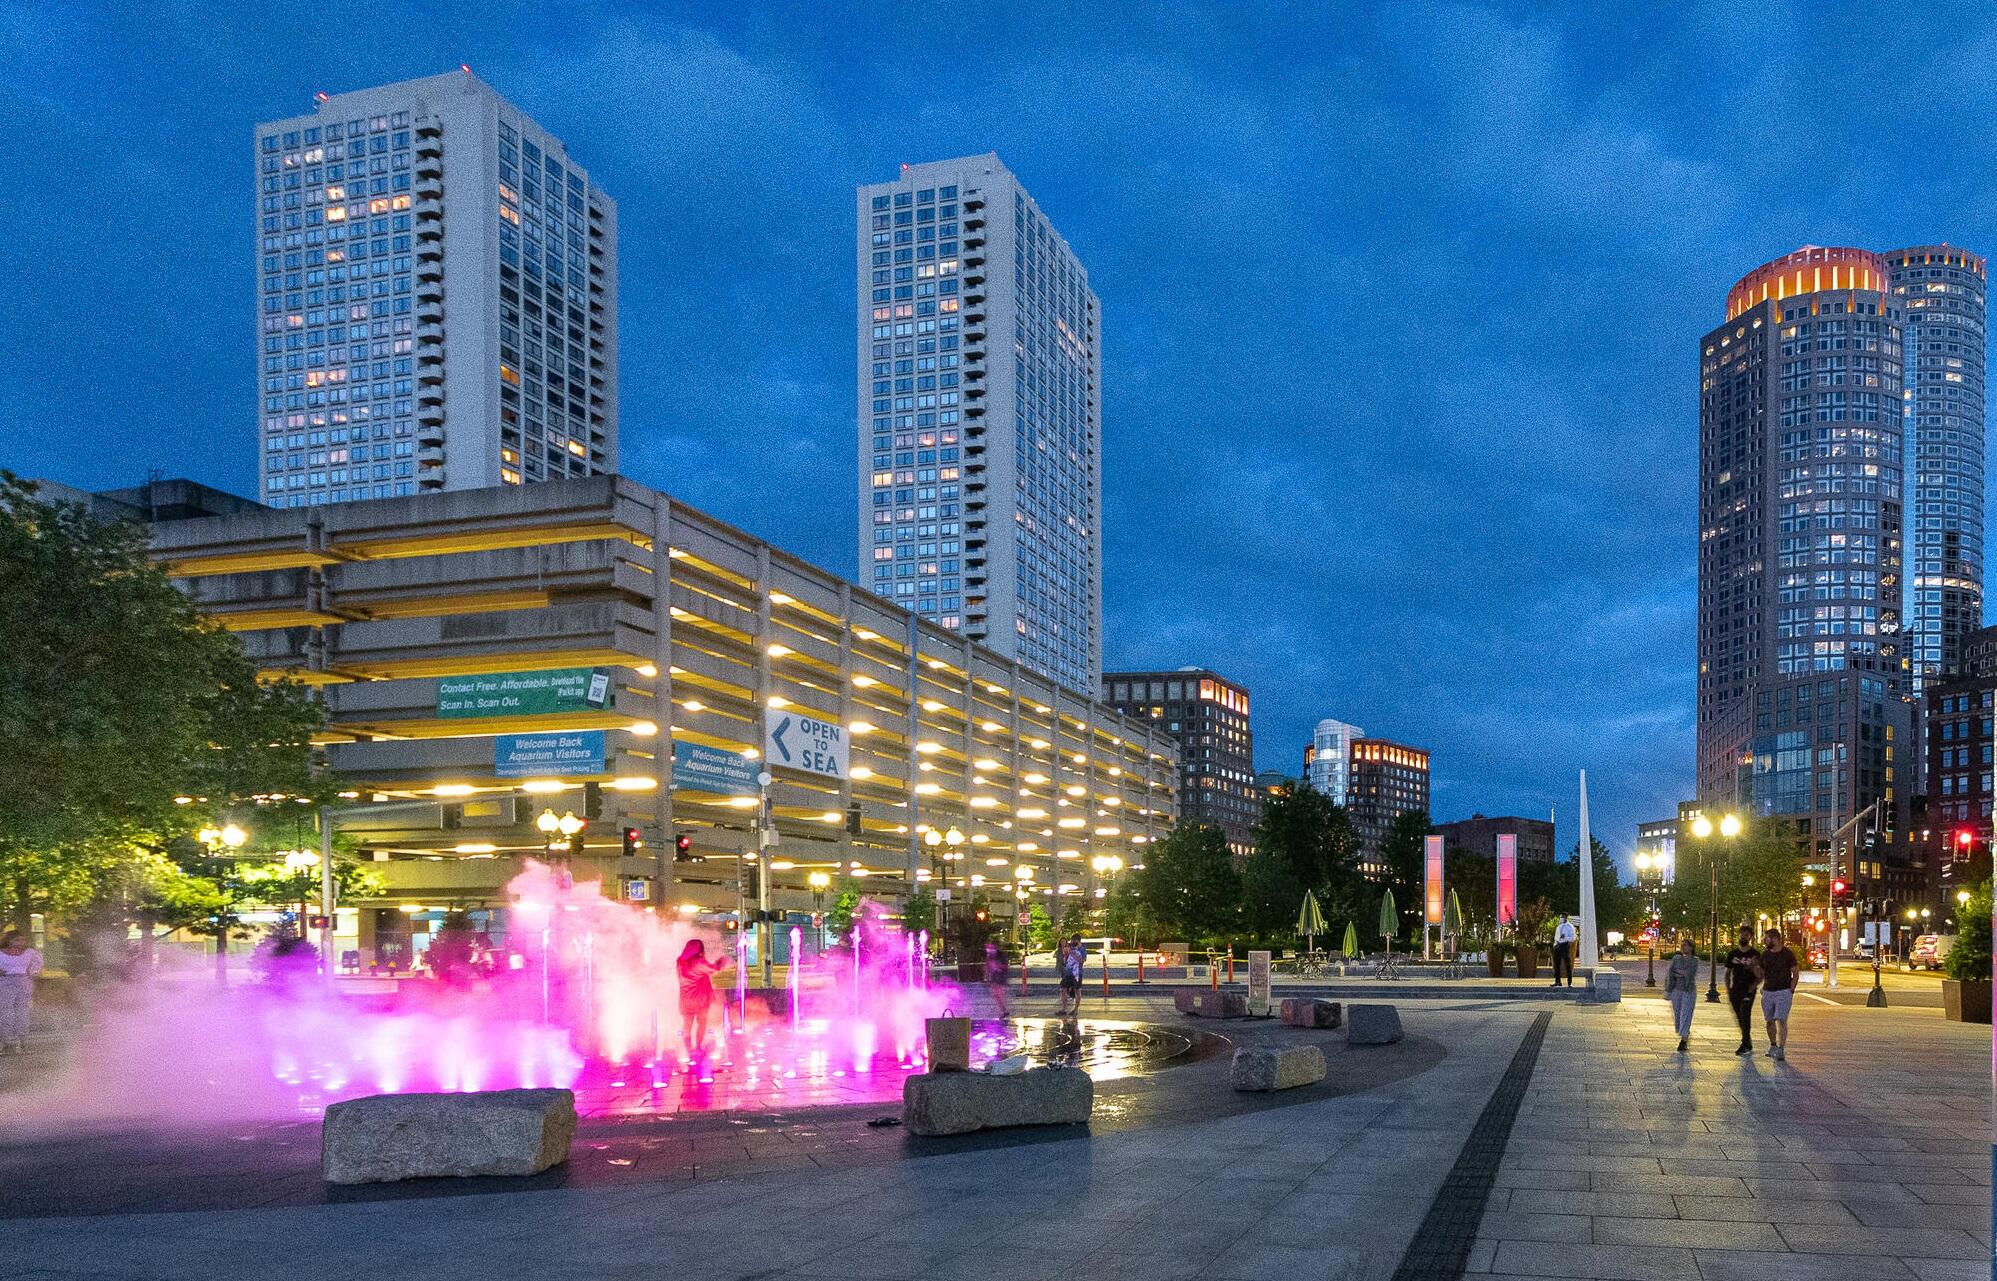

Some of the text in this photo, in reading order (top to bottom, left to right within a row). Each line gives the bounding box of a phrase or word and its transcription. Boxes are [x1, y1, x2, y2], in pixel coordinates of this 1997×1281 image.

[440, 683, 474, 693] Contact
[440, 700, 462, 710] Scan
[477, 698, 500, 708] Scan
[800, 718, 840, 742] OPEN
[515, 737, 583, 750] Welcome Back
[813, 738, 828, 751] TO
[508, 749, 592, 761] Aquarium Visitors
[692, 749, 745, 768] Welcome Back
[802, 749, 839, 775] SEA
[684, 759, 752, 780] Aquarium Visitors
